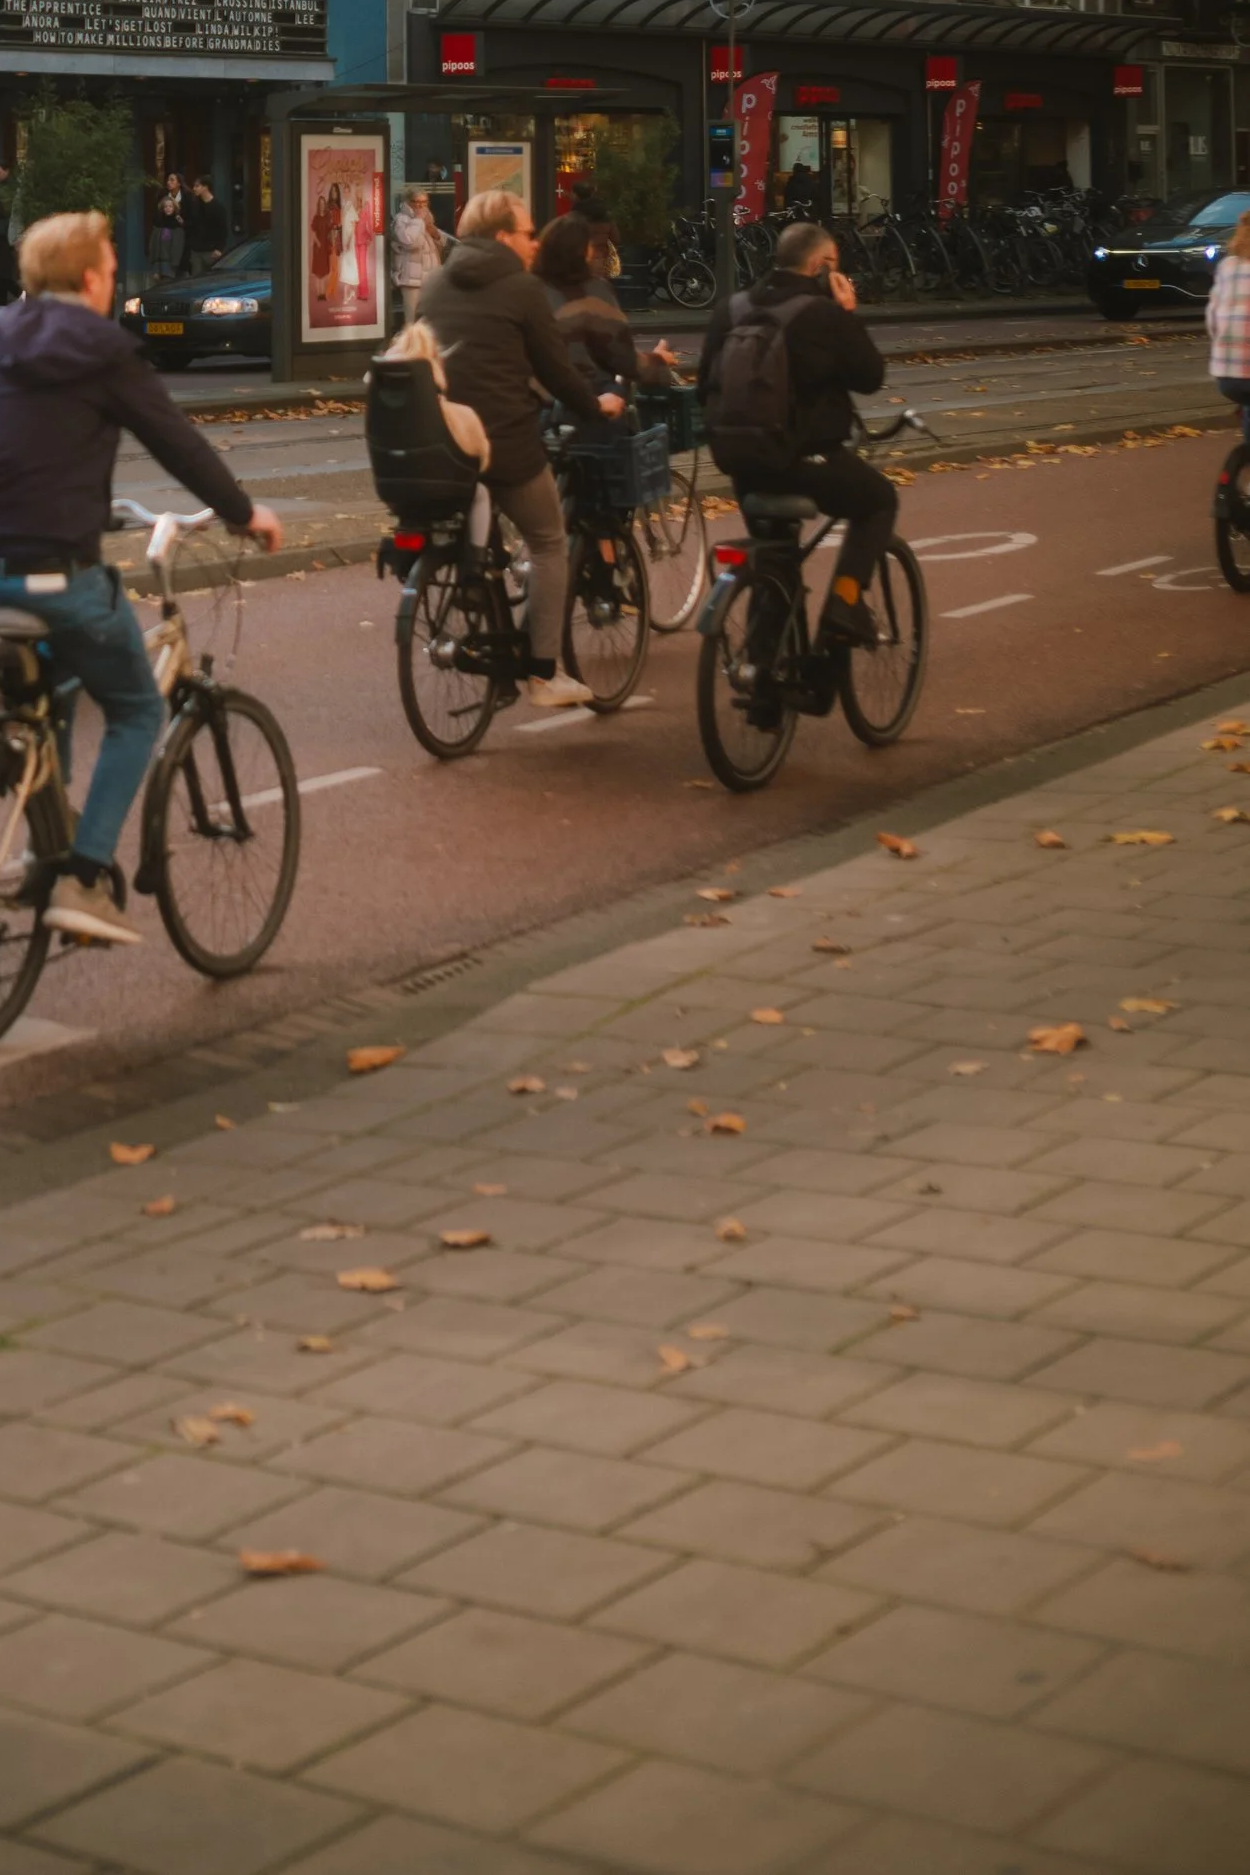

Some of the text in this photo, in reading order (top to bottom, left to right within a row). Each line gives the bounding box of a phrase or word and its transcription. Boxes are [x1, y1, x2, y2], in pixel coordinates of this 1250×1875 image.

[6, 0, 315, 25] THE APPRENTICE QUAND VIENT L'AUTOMNE LEE
[24, 15, 59, 28] ANORA
[87, 18, 120, 31] LET'S
[123, 20, 143, 32] GET
[146, 21, 172, 33] LOST
[198, 24, 228, 35] LINDA
[254, 26, 279, 38] KIP!
[34, 31, 280, 51] HOW TO MAKE MILLIONS BEFORE GRANDMA DIES
[442, 60, 475, 72] pipoos
[926, 78, 956, 89] pipoos
